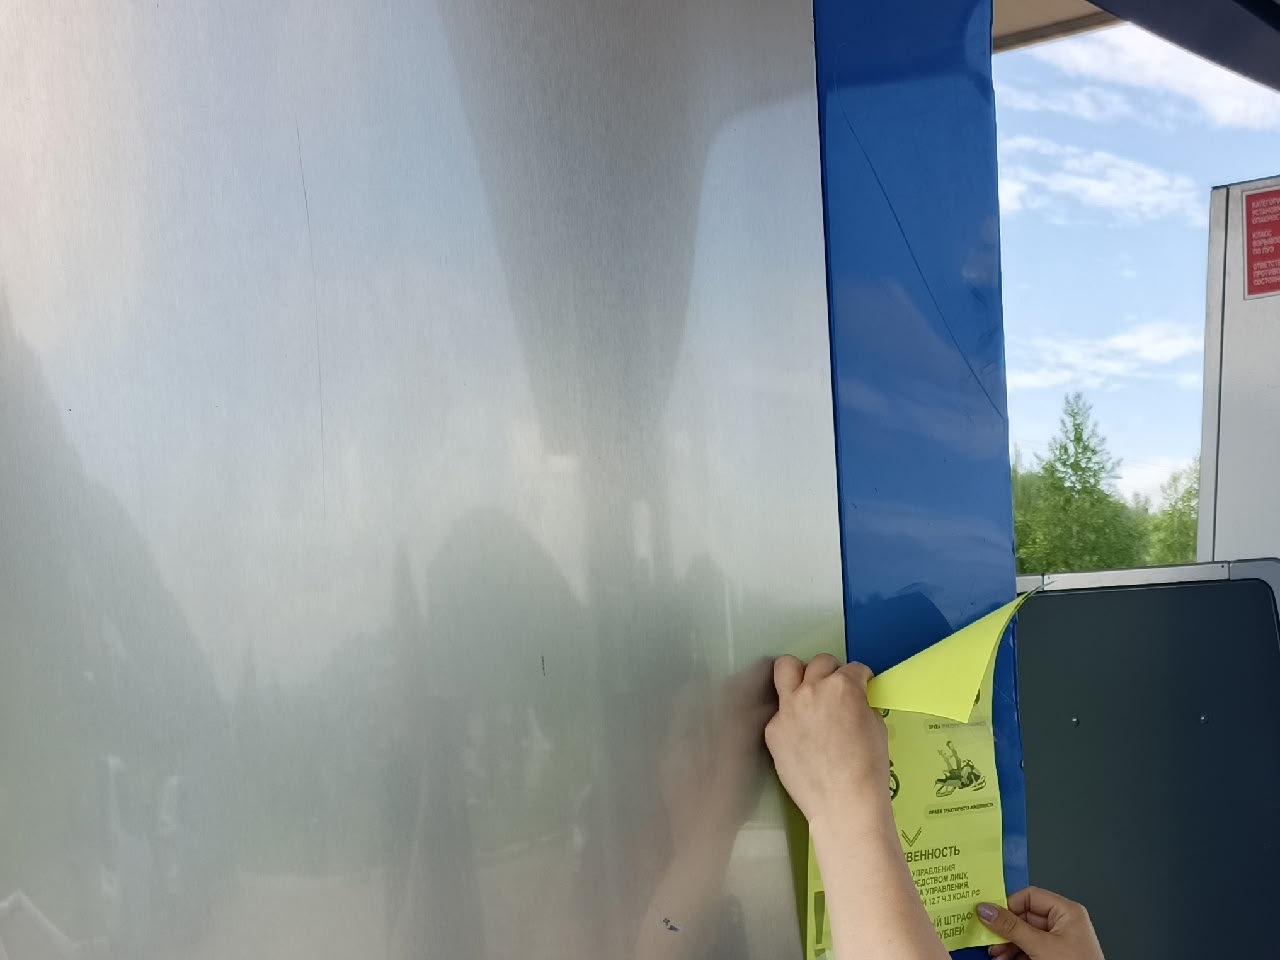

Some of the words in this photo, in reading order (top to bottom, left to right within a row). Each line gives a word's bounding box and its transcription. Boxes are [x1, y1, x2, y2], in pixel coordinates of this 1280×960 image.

[904, 845, 960, 863] ВЕННОСТЬ
[944, 911, 973, 926] ШТРАФ
[937, 923, 965, 939] УБЛЕЙ
